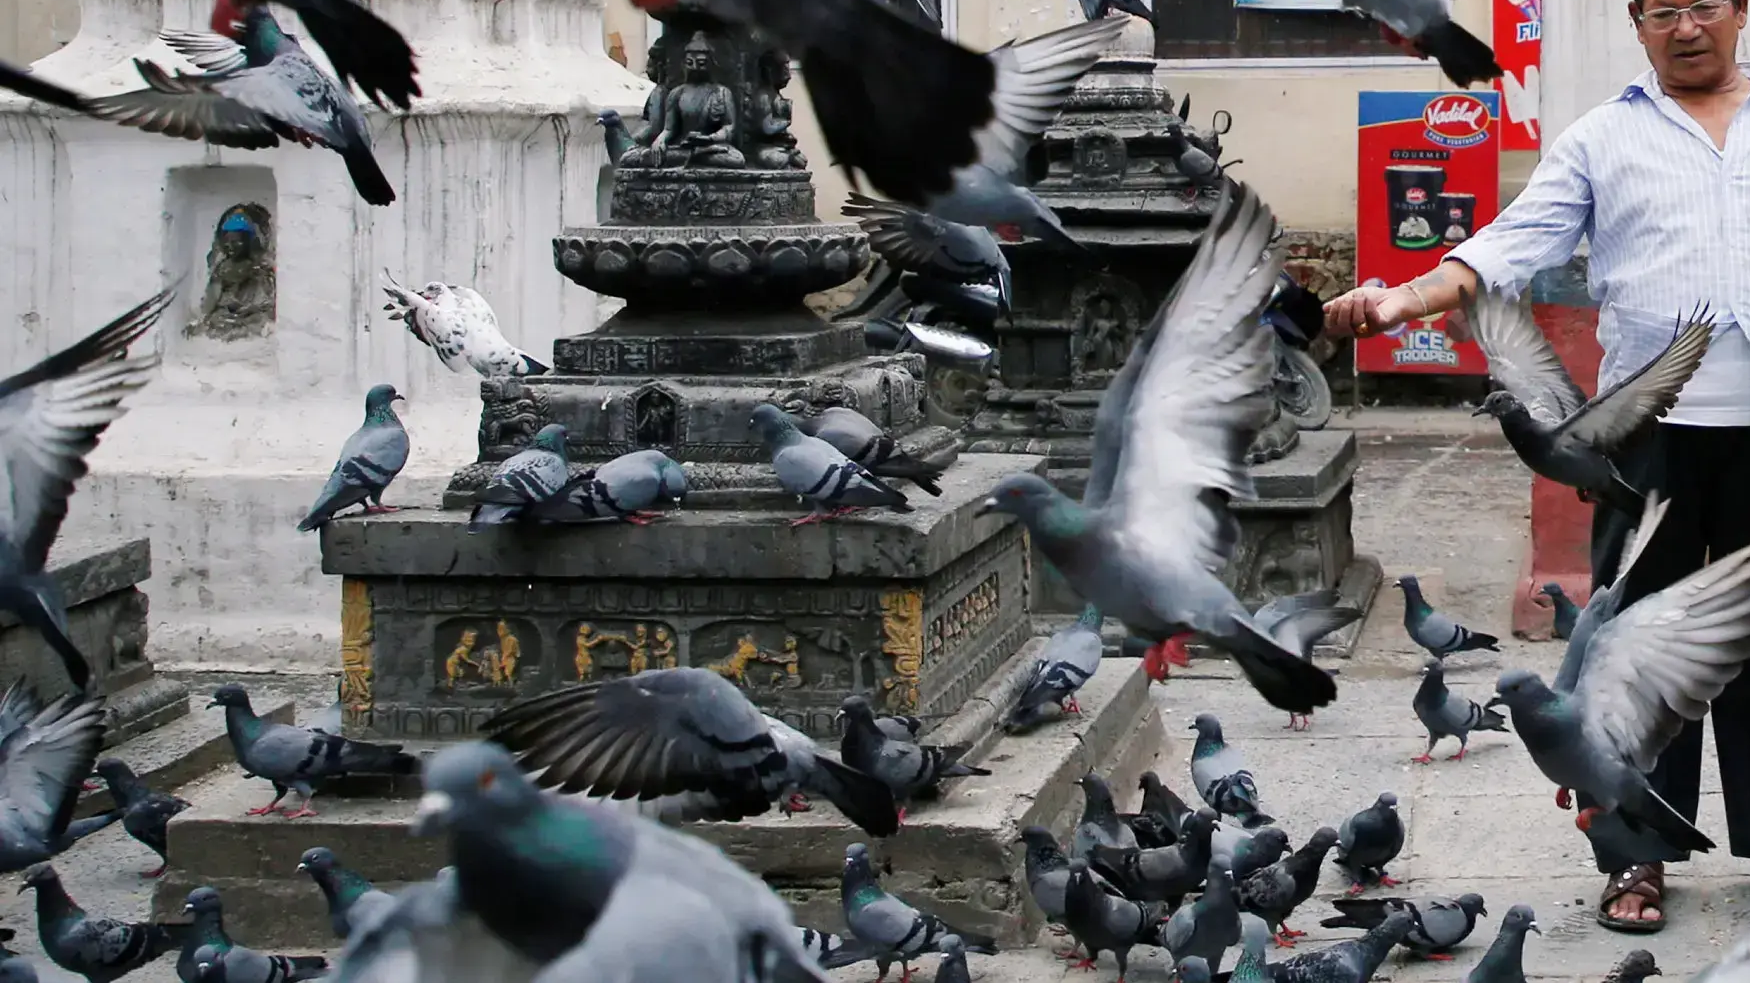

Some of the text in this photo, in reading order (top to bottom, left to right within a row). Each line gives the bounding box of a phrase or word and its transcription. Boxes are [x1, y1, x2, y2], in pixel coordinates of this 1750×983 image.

[1517, 23, 1541, 42] Fli
[1427, 99, 1484, 131] Vadilal
[1392, 150, 1448, 159] GOURMET
[1408, 330, 1445, 350] ICE
[1394, 349, 1457, 365] TROOPER
